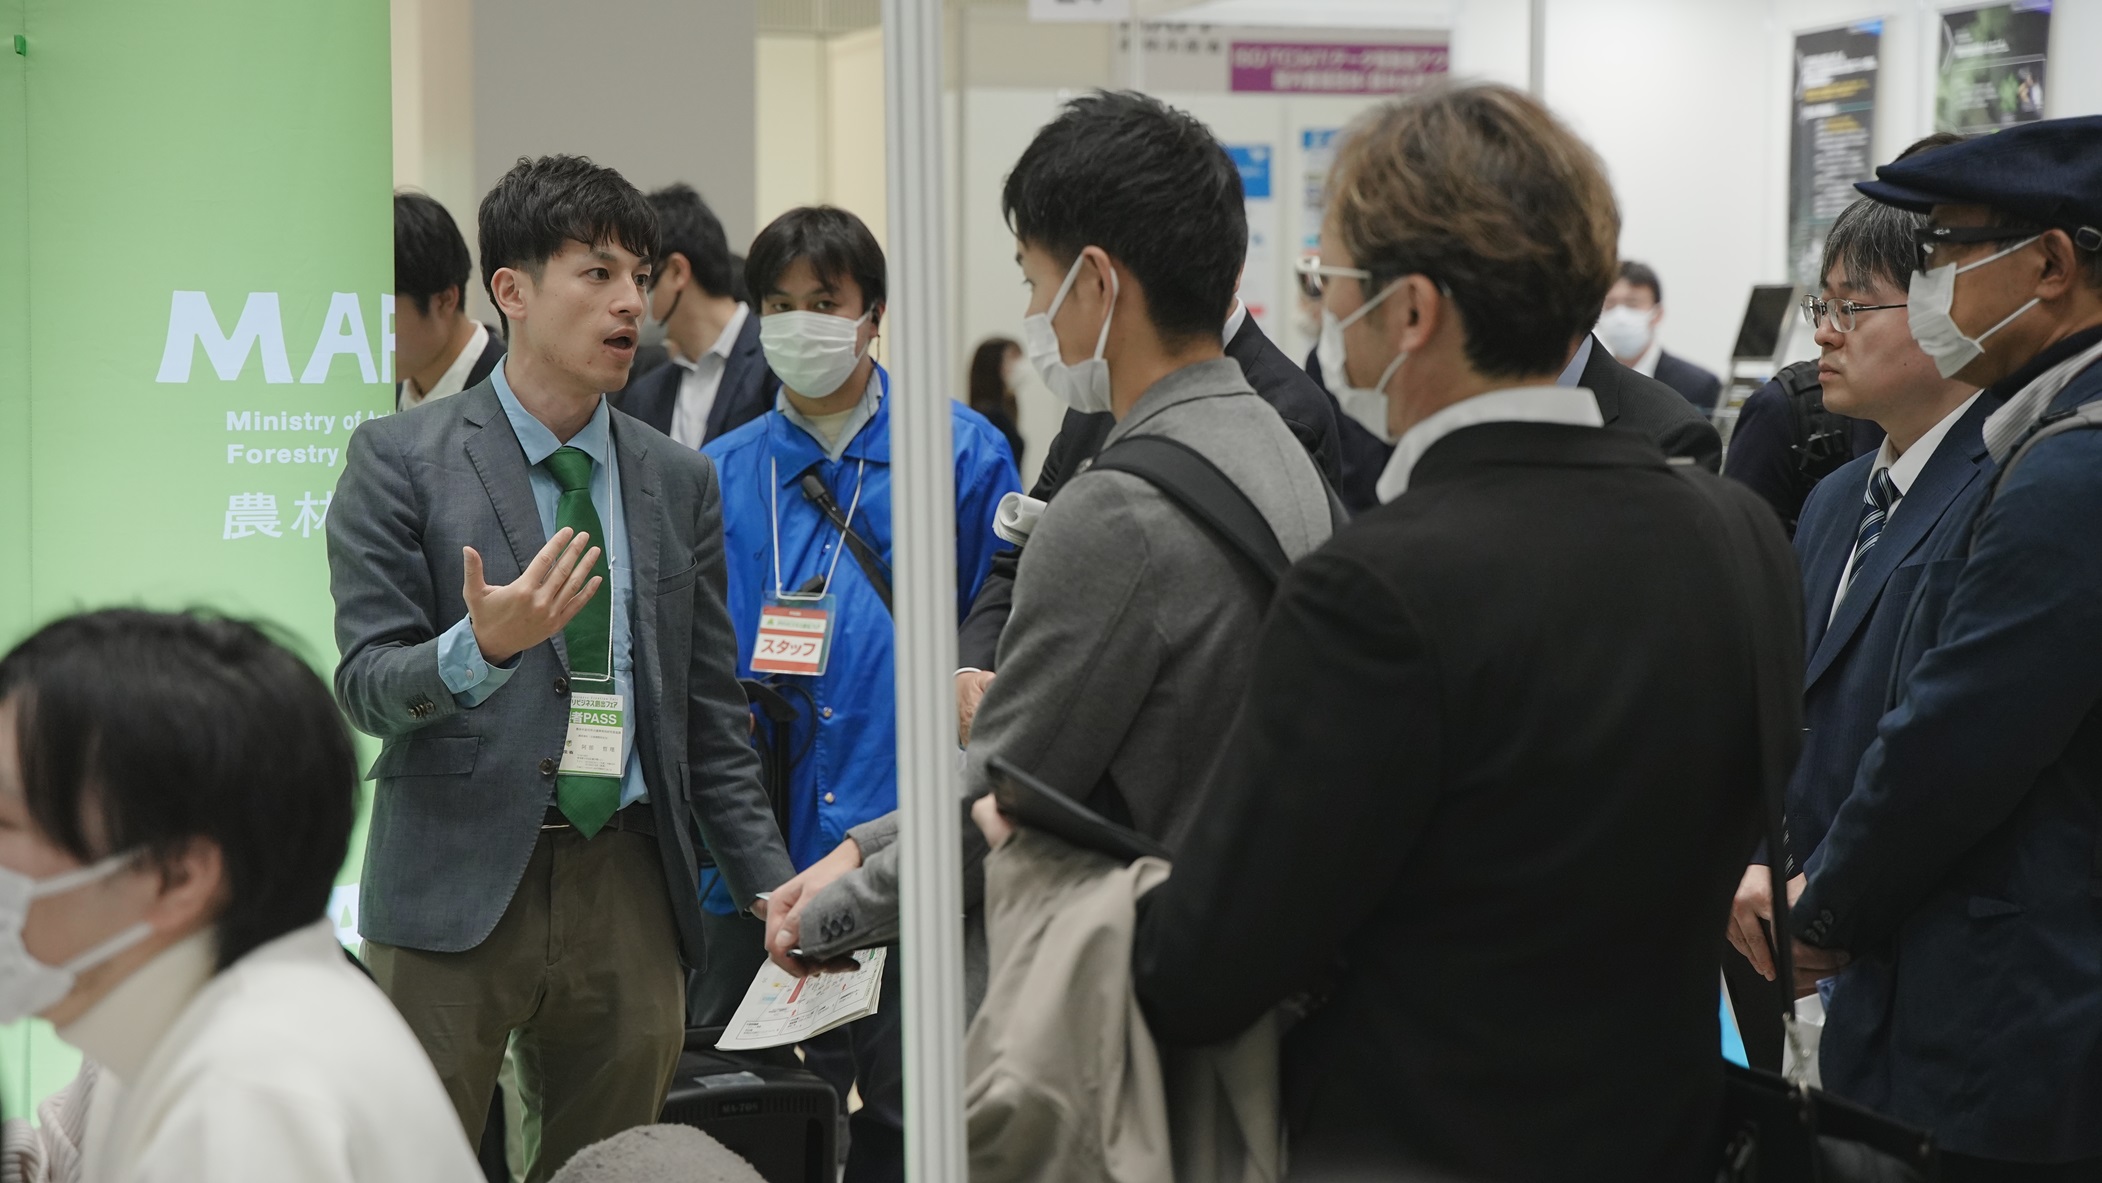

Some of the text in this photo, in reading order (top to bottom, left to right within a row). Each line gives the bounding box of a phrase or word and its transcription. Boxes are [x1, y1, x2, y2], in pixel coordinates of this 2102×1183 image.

[226, 411, 336, 435] Ministry
[343, 410, 362, 430] of
[227, 444, 339, 467] Forestry
[223, 491, 333, 540] 農林
[761, 639, 816, 657] スタッフ
[569, 711, 617, 725] 者PASS
